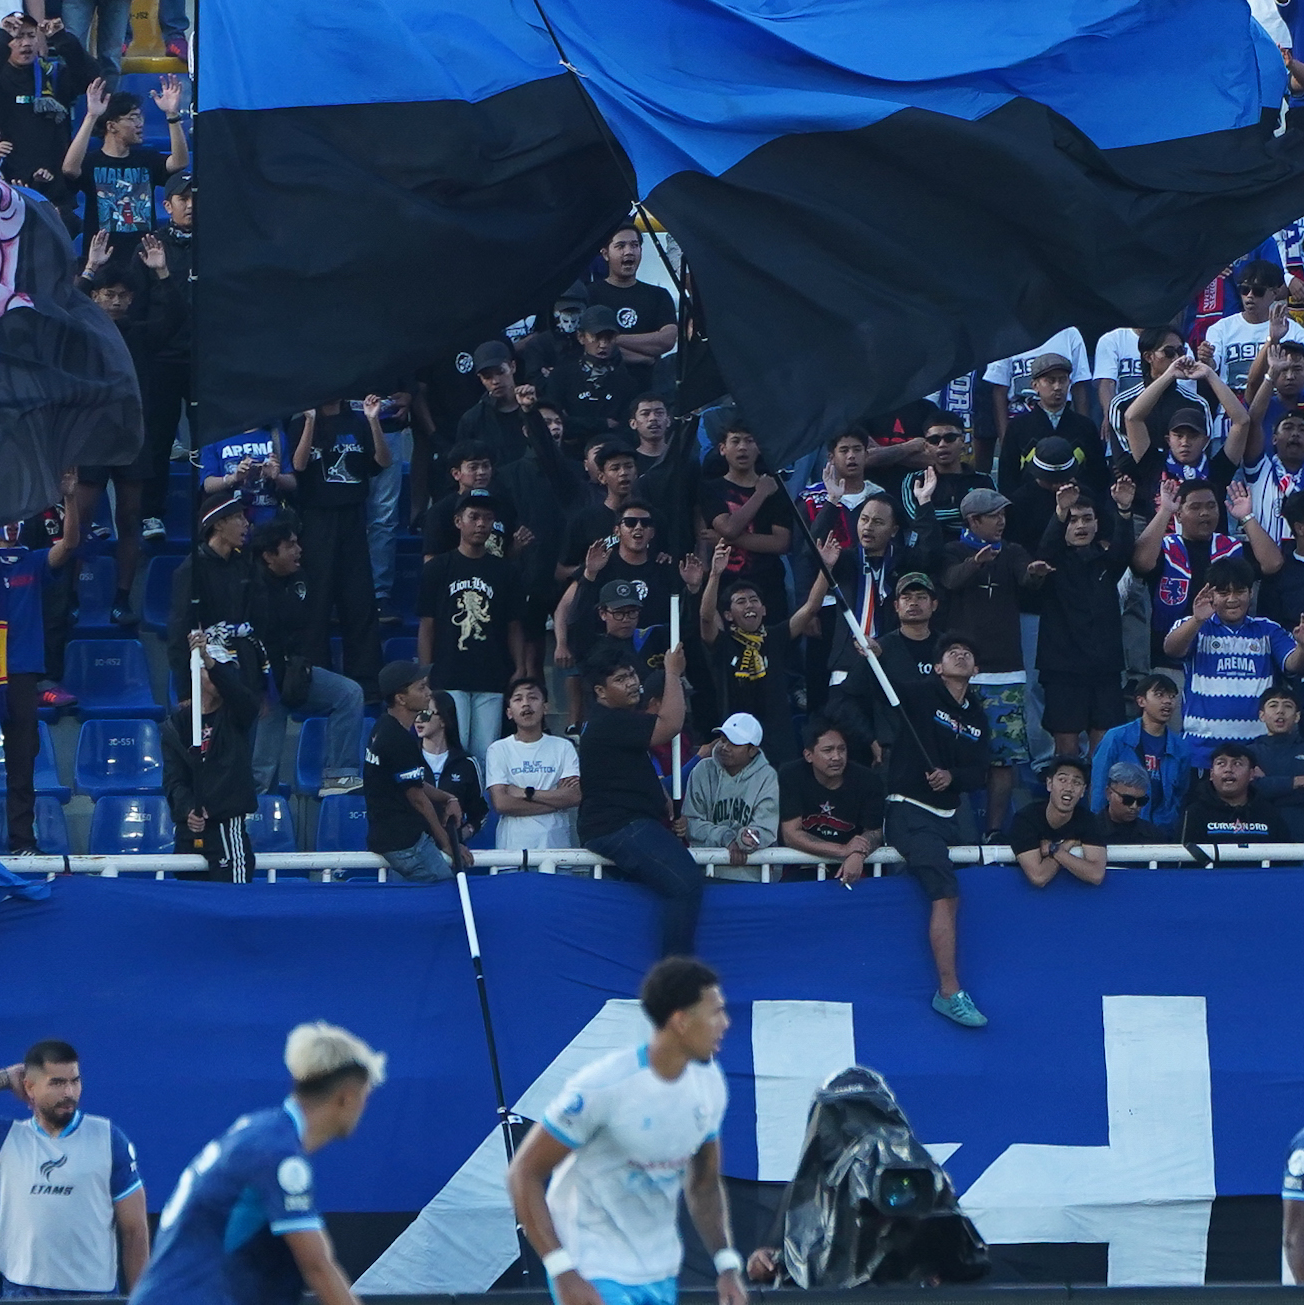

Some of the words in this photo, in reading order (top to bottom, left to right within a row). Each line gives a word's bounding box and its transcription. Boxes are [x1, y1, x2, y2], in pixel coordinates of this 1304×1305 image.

[93, 167, 150, 184] MALANG
[1216, 657, 1256, 673] AREMA
[108, 738, 135, 746] 3C-S51
